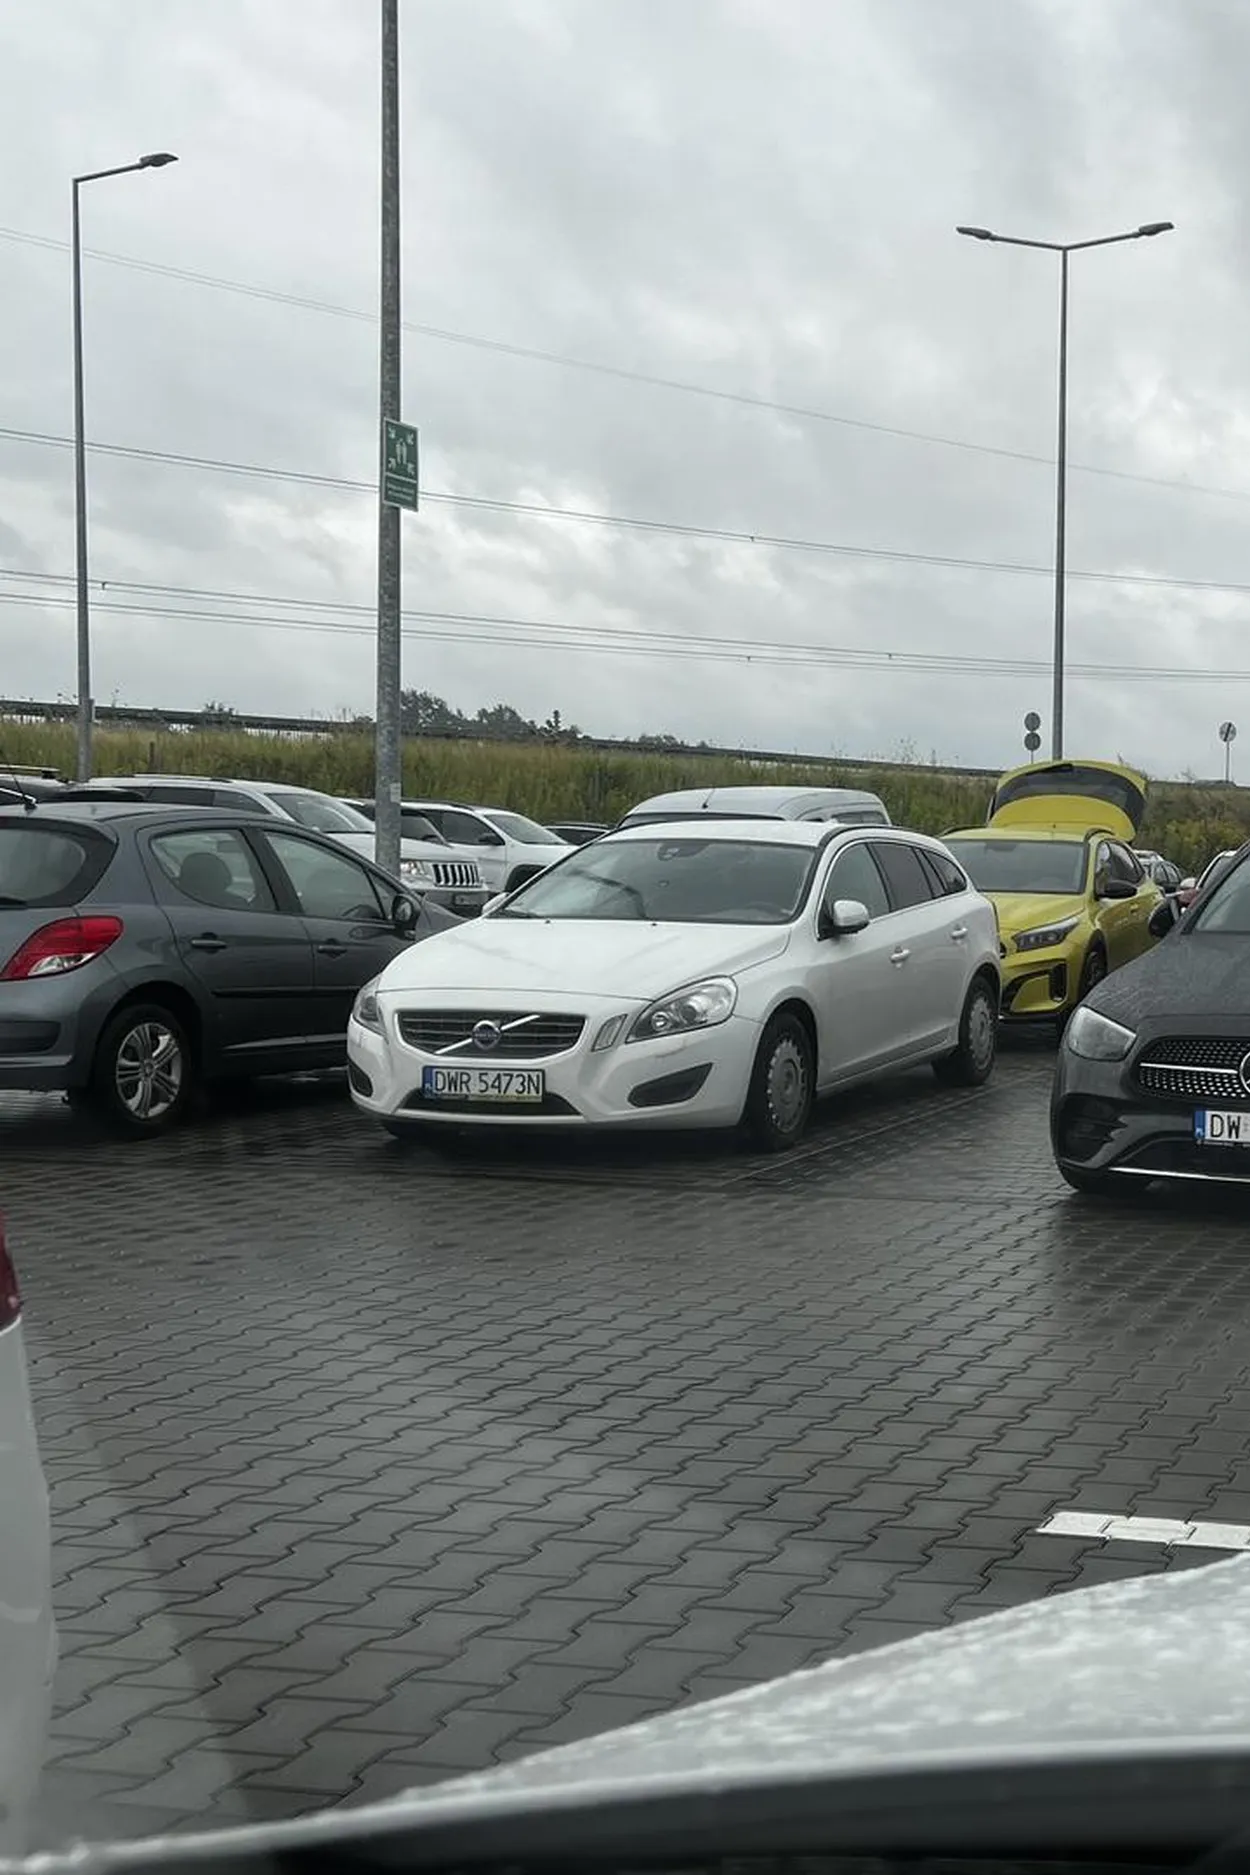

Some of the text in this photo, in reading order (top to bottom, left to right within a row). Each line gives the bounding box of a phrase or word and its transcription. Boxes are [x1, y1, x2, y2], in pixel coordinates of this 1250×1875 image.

[434, 1070, 541, 1095] DWR 5473N
[1210, 1113, 1241, 1140] DW
